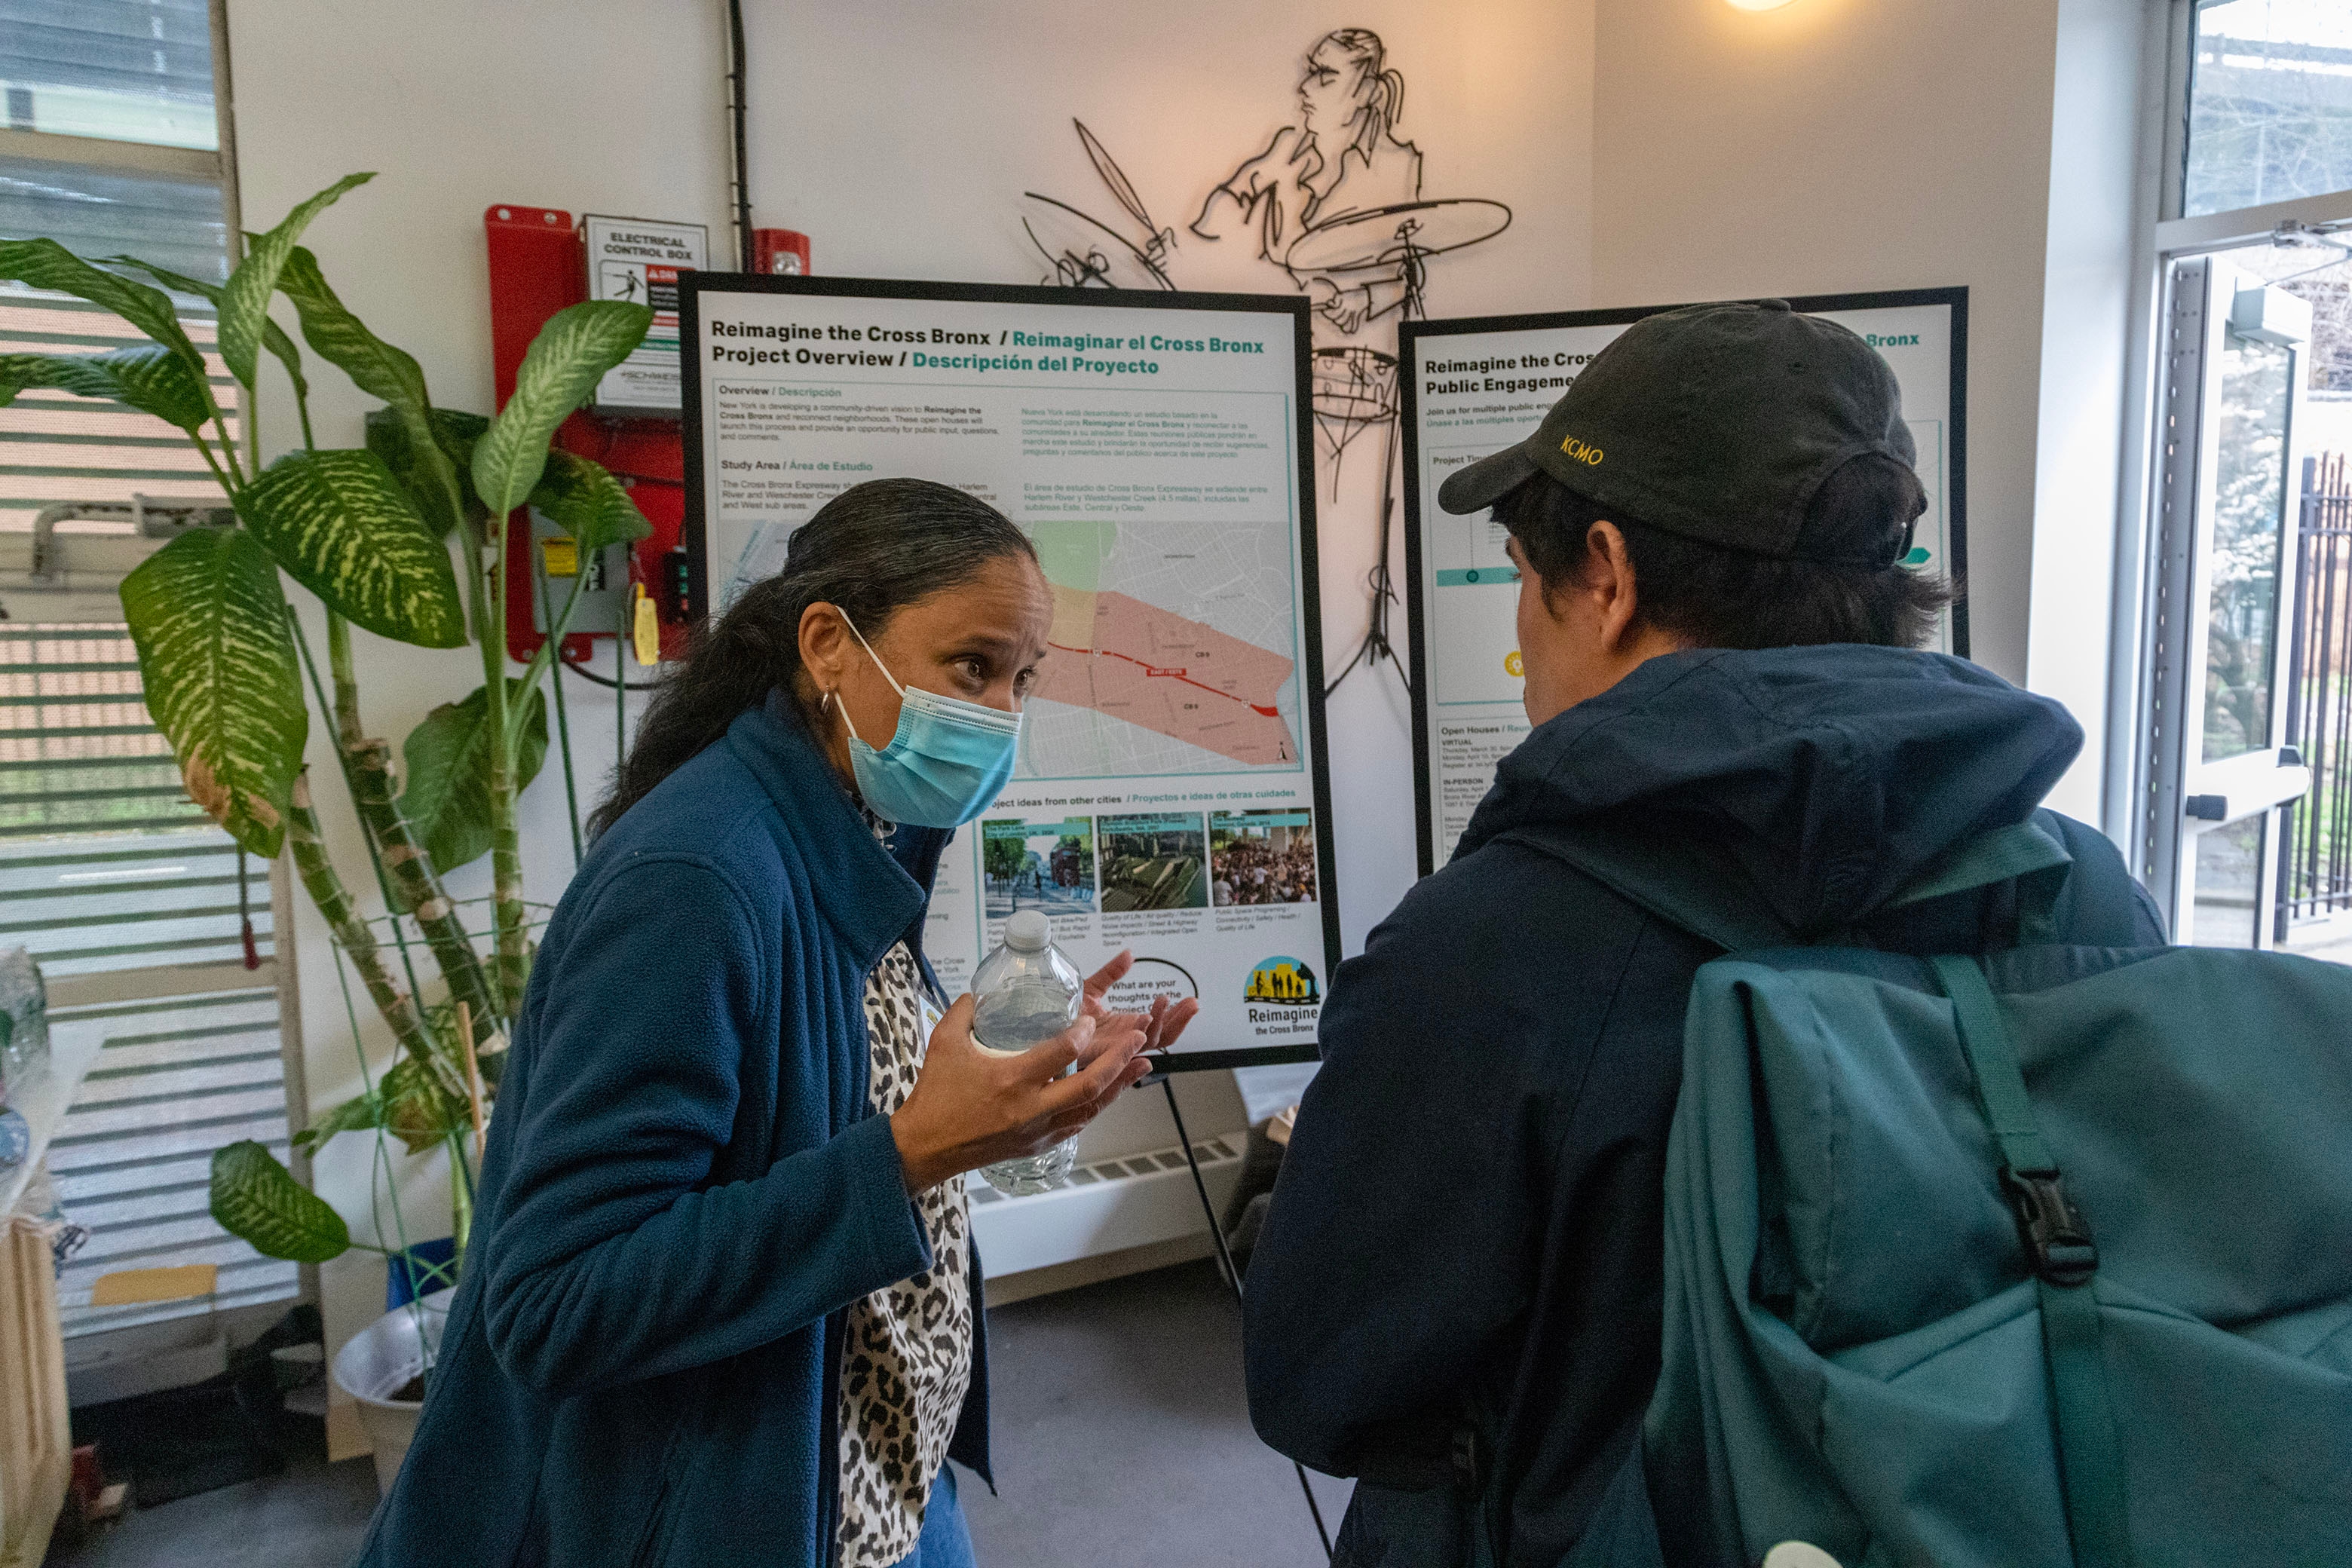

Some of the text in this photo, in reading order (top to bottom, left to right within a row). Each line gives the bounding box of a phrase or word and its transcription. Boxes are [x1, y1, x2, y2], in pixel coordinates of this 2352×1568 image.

[611, 232, 686, 247] ELECTRICAL
[605, 244, 692, 260] CONTROL BOX
[711, 320, 822, 341] Reimagine
[826, 325, 862, 341] the
[866, 326, 926, 343] Cross
[931, 328, 991, 345] Bronx
[1012, 331, 1124, 351] Reimaginar
[1128, 335, 1145, 350] el
[1150, 335, 1205, 351] Cross
[1208, 337, 1263, 353] Bronx
[712, 346, 791, 365] Project
[795, 348, 894, 366] Overview
[912, 352, 1033, 371] Descripción
[1037, 356, 1067, 371] del
[1072, 357, 1159, 375] Proyecto
[1425, 334, 1919, 373] Reimagine the Cros Bronx
[718, 385, 770, 395] Overview
[778, 387, 841, 397] Descripción
[1426, 376, 1574, 394] Public Engageme
[1426, 408, 1444, 416] Join
[1472, 405, 1505, 413] multiple
[1508, 403, 1533, 412] public
[1536, 403, 1554, 411] eng
[1560, 433, 1604, 465] KCMO
[721, 460, 752, 471] Study
[755, 461, 780, 470] Area
[789, 460, 814, 470] Área
[816, 461, 830, 470] de
[832, 461, 873, 471] Estudio
[1433, 455, 1465, 466] Project
[1441, 727, 1464, 736] Open
[992, 799, 1015, 810] oject
[1017, 798, 1043, 807] ideas
[1132, 794, 1178, 804] Proyectos
[1255, 789, 1296, 798] cuidades
[1112, 982, 1135, 990] What
[1156, 980, 1176, 989] your
[1108, 992, 1150, 1003] thoughts
[1249, 1008, 1318, 1024] Reimagine
[1255, 1024, 1313, 1035] the Cross Bronx
